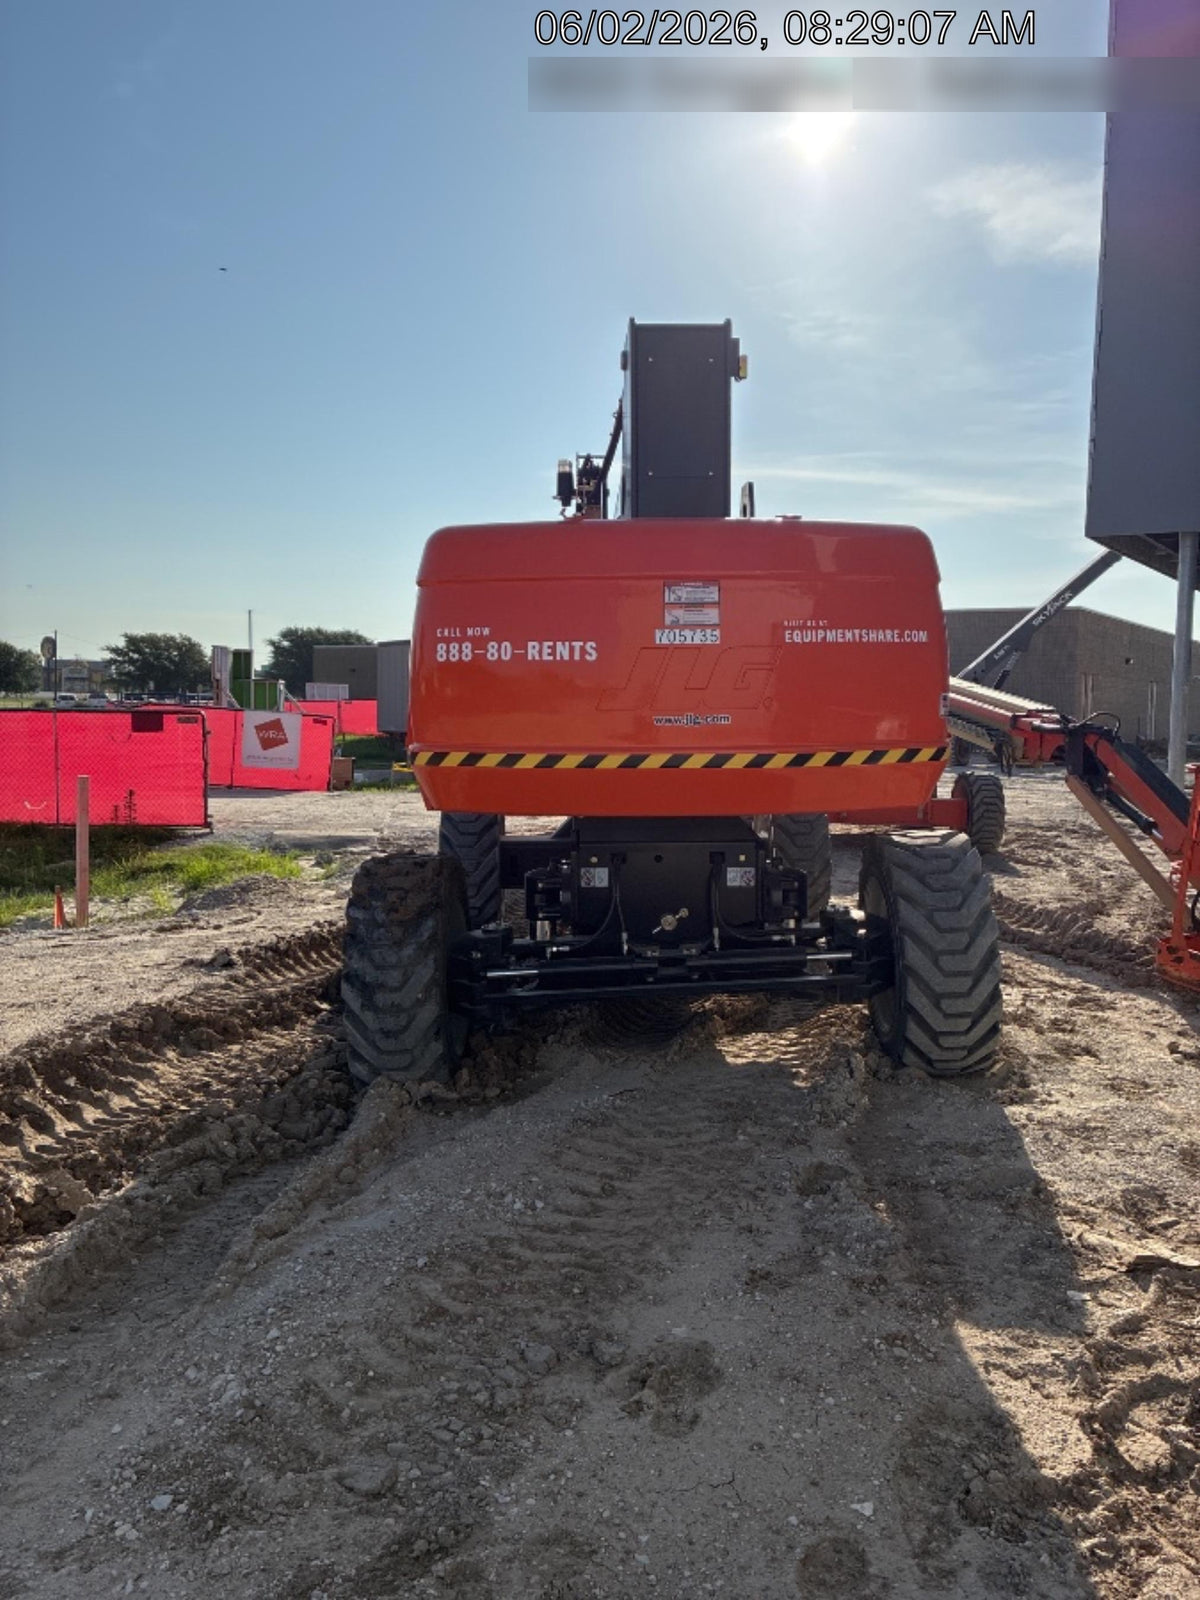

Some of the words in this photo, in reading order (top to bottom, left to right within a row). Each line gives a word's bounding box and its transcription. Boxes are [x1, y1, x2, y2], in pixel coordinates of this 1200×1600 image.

[436, 627, 461, 637] CALL
[467, 627, 491, 637] NOW
[658, 629, 719, 643] 705735
[784, 628, 928, 644] EQUIPMENTSHARE.COM
[436, 641, 598, 662] 888-80-RENTS
[595, 645, 783, 712] JLG
[653, 713, 731, 726] www.jlg.com
